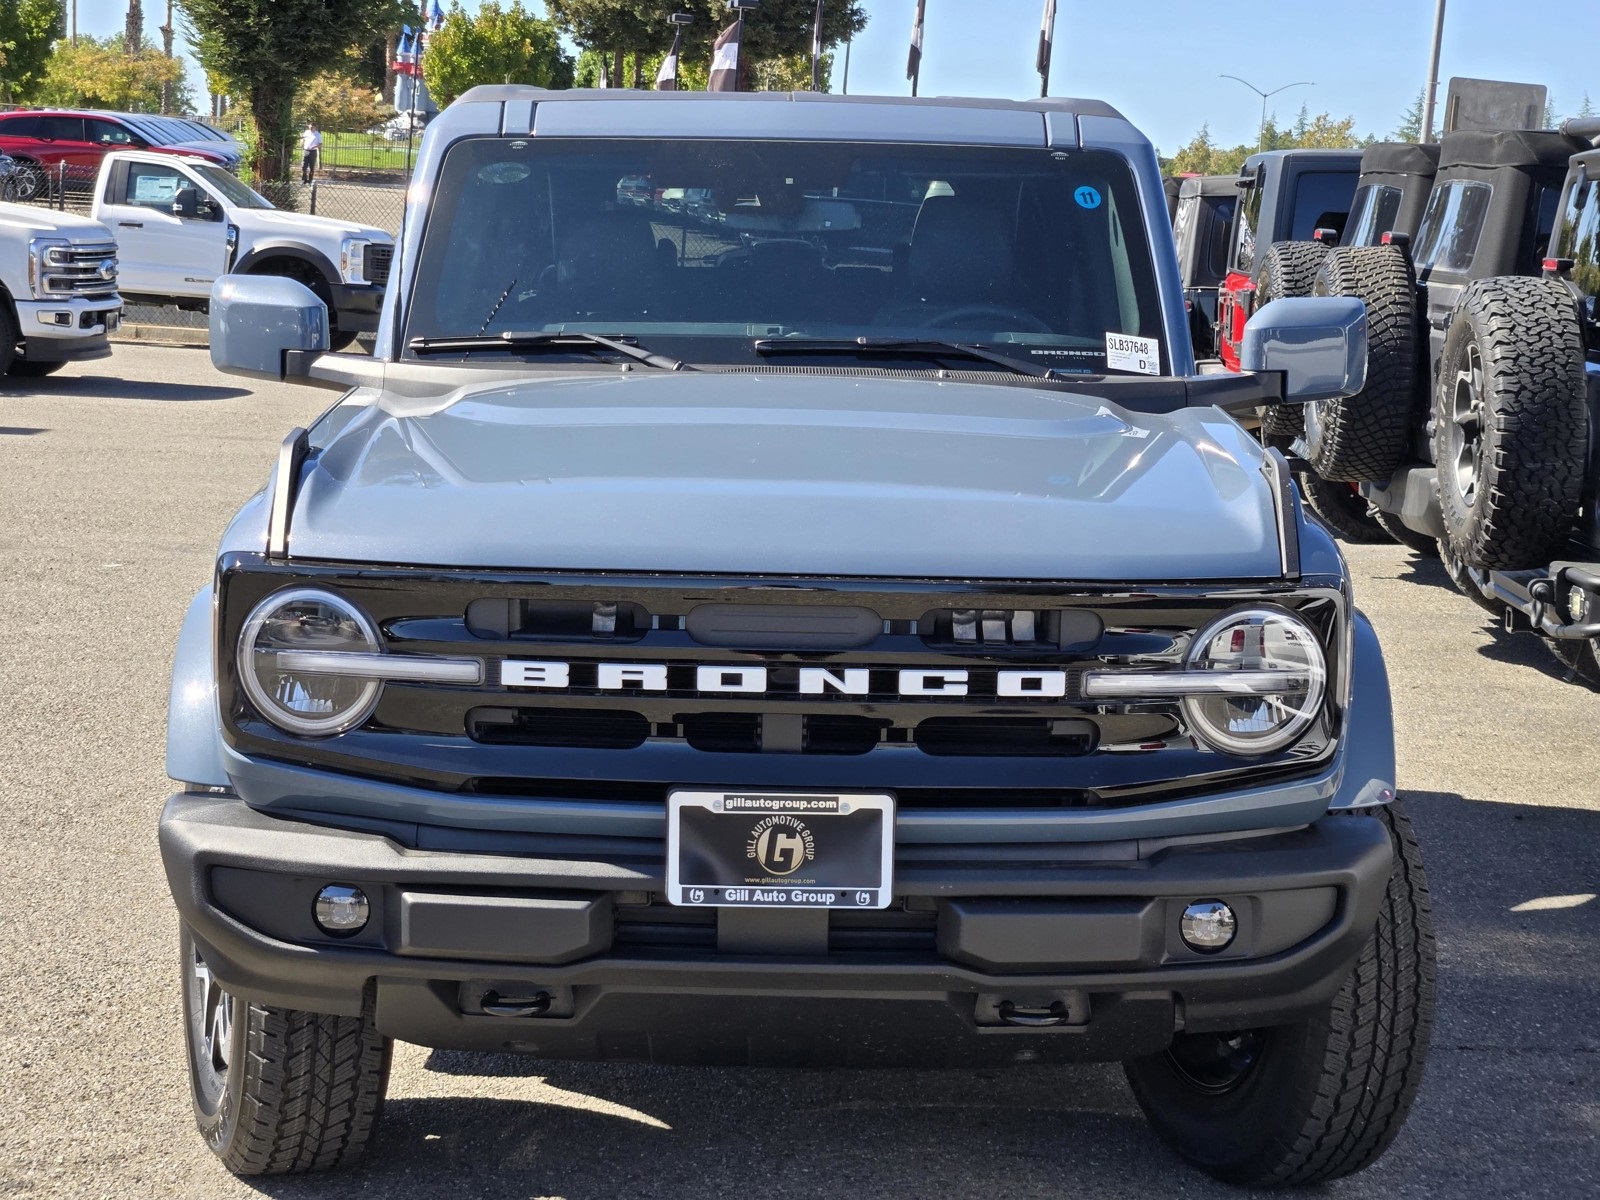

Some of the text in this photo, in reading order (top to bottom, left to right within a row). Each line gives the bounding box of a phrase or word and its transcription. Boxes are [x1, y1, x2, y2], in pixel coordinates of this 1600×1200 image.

[1079, 191, 1095, 204] 11
[1107, 337, 1149, 355] SLB37648
[1139, 359, 1147, 370] D
[501, 659, 1066, 696] BRONCO
[725, 797, 837, 810] gillautogroup.com
[746, 815, 815, 860] GILL AUTOMOTIVE GROUP
[744, 877, 816, 885] www.gillautogroup.com
[724, 889, 749, 902] Gill
[752, 890, 787, 902] Auto
[791, 890, 836, 905] Group
